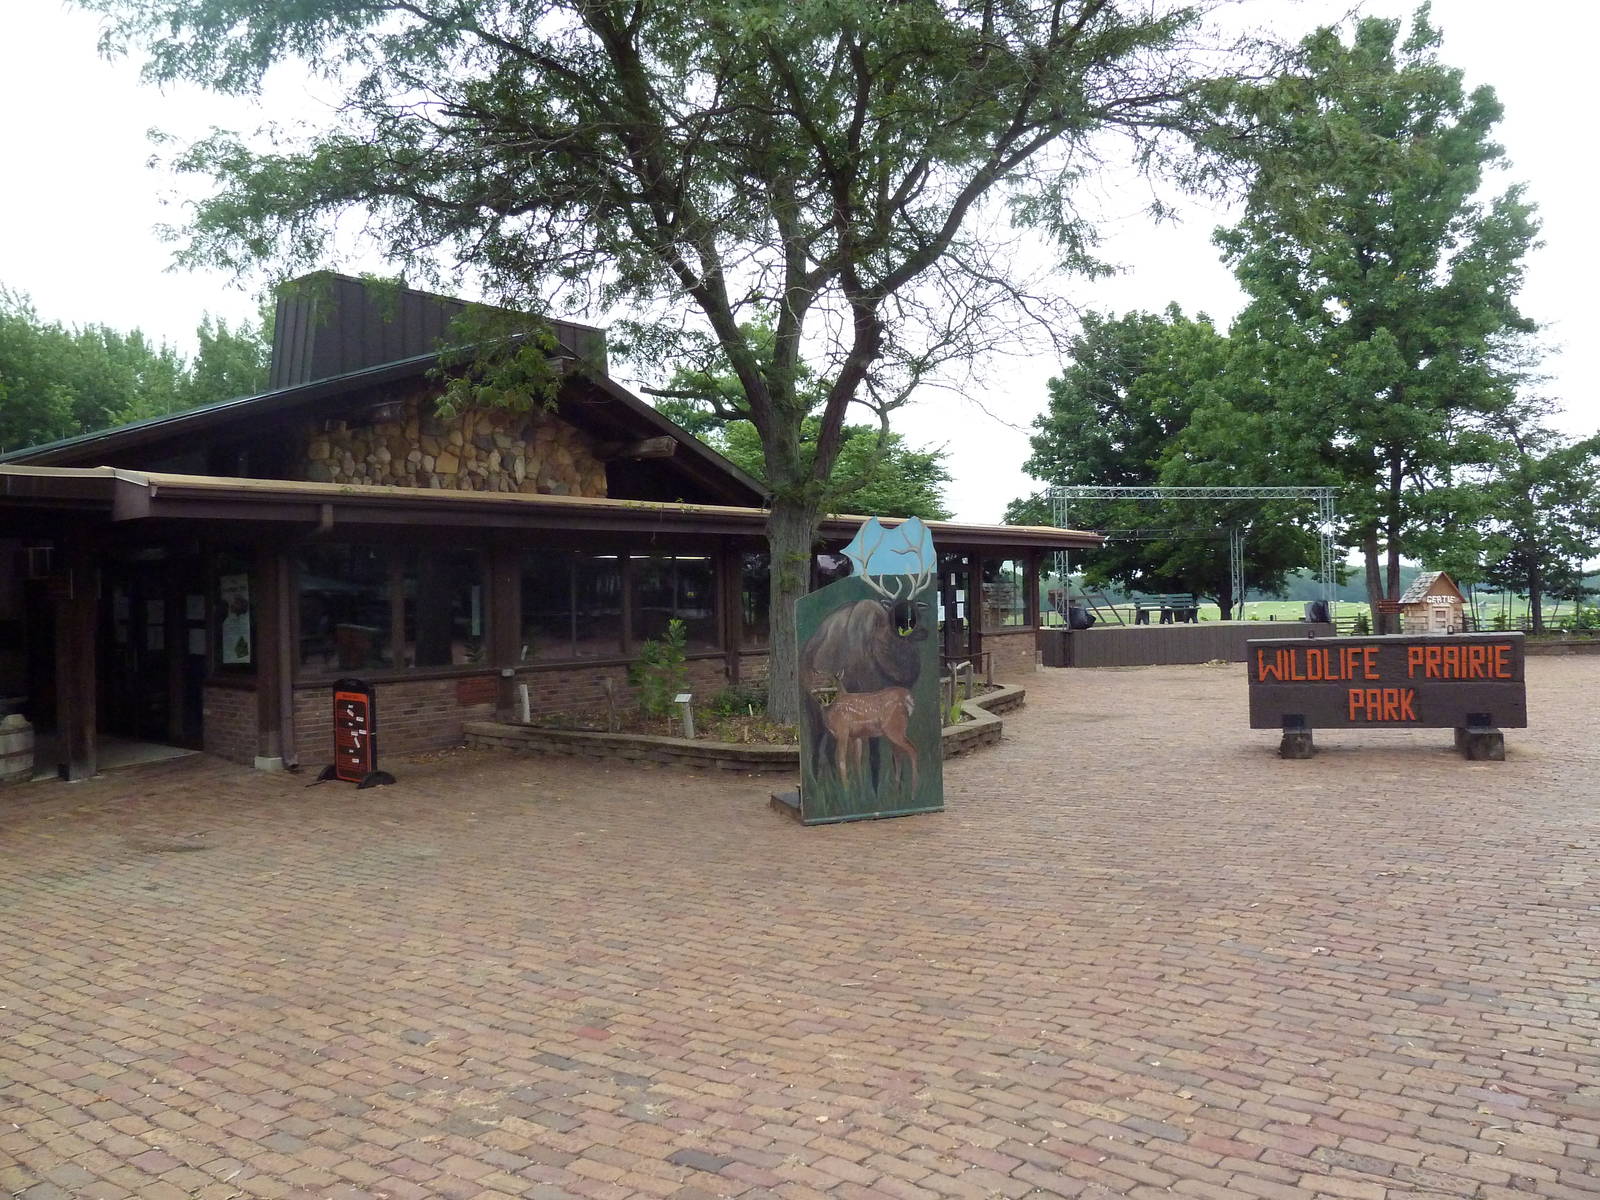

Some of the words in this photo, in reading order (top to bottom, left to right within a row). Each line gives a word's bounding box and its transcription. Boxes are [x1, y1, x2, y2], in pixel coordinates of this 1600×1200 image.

[1257, 647, 1380, 682] WILDLIFE
[1407, 645, 1513, 679] PRAIRIE
[1349, 688, 1417, 721] PARK
